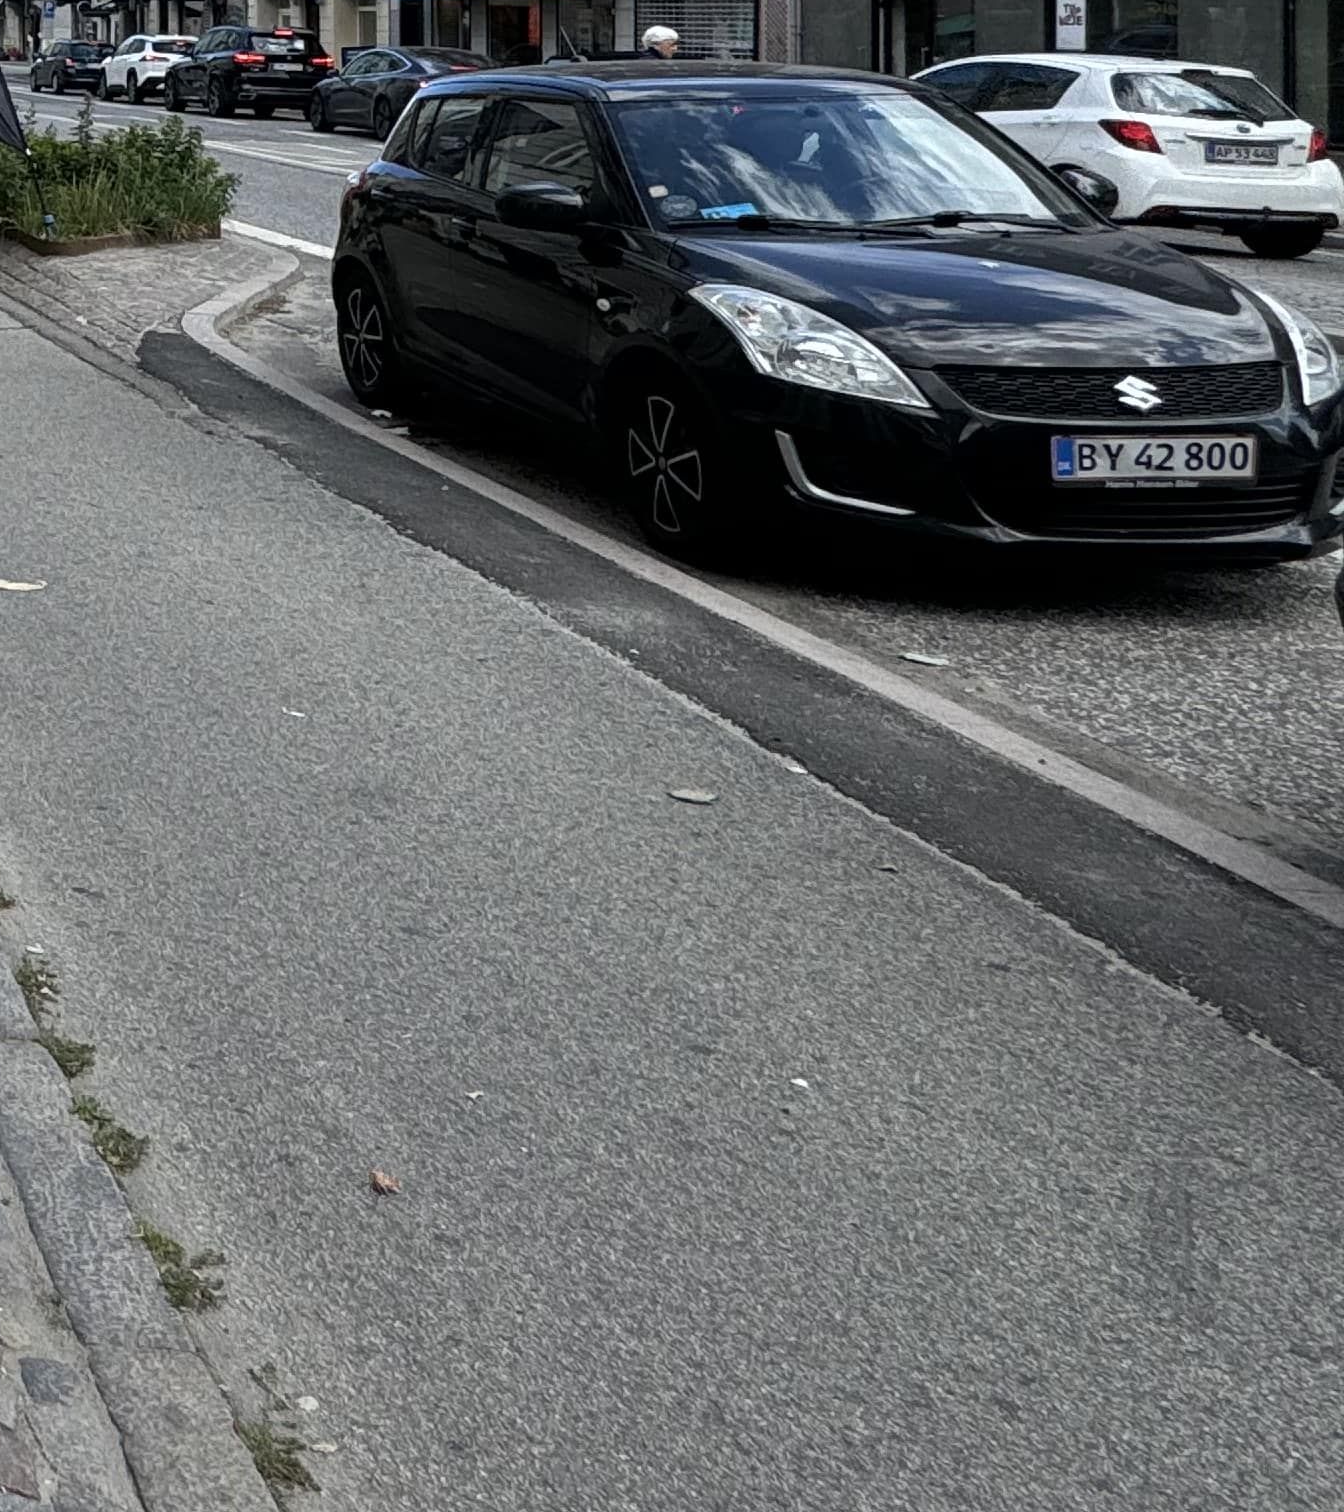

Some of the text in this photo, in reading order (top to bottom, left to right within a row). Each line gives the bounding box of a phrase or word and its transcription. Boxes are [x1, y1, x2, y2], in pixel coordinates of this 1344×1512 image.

[1077, 441, 1250, 472] BY 42 800
